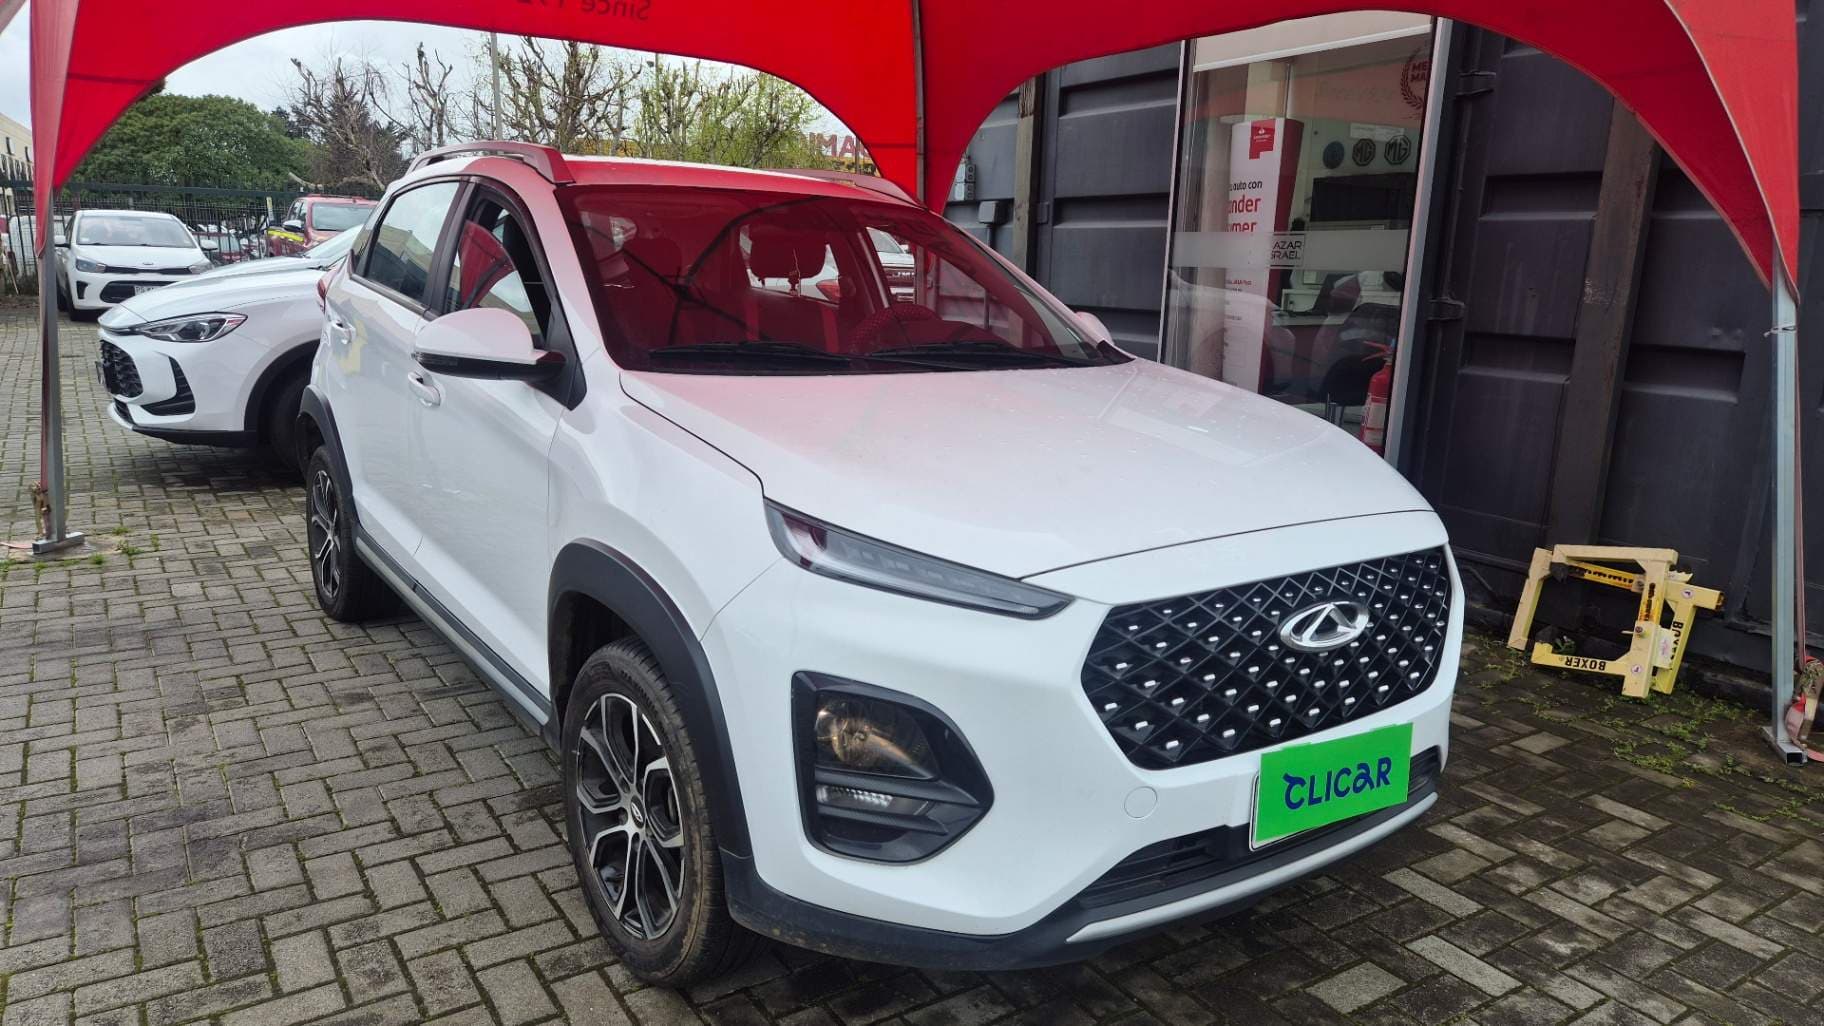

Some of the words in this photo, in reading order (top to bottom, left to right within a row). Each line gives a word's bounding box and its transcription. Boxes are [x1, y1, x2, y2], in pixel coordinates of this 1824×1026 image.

[1384, 135, 1411, 165] MG
[1247, 180, 1263, 190] con
[1229, 194, 1261, 213] nder
[1565, 656, 1606, 671] BOXER
